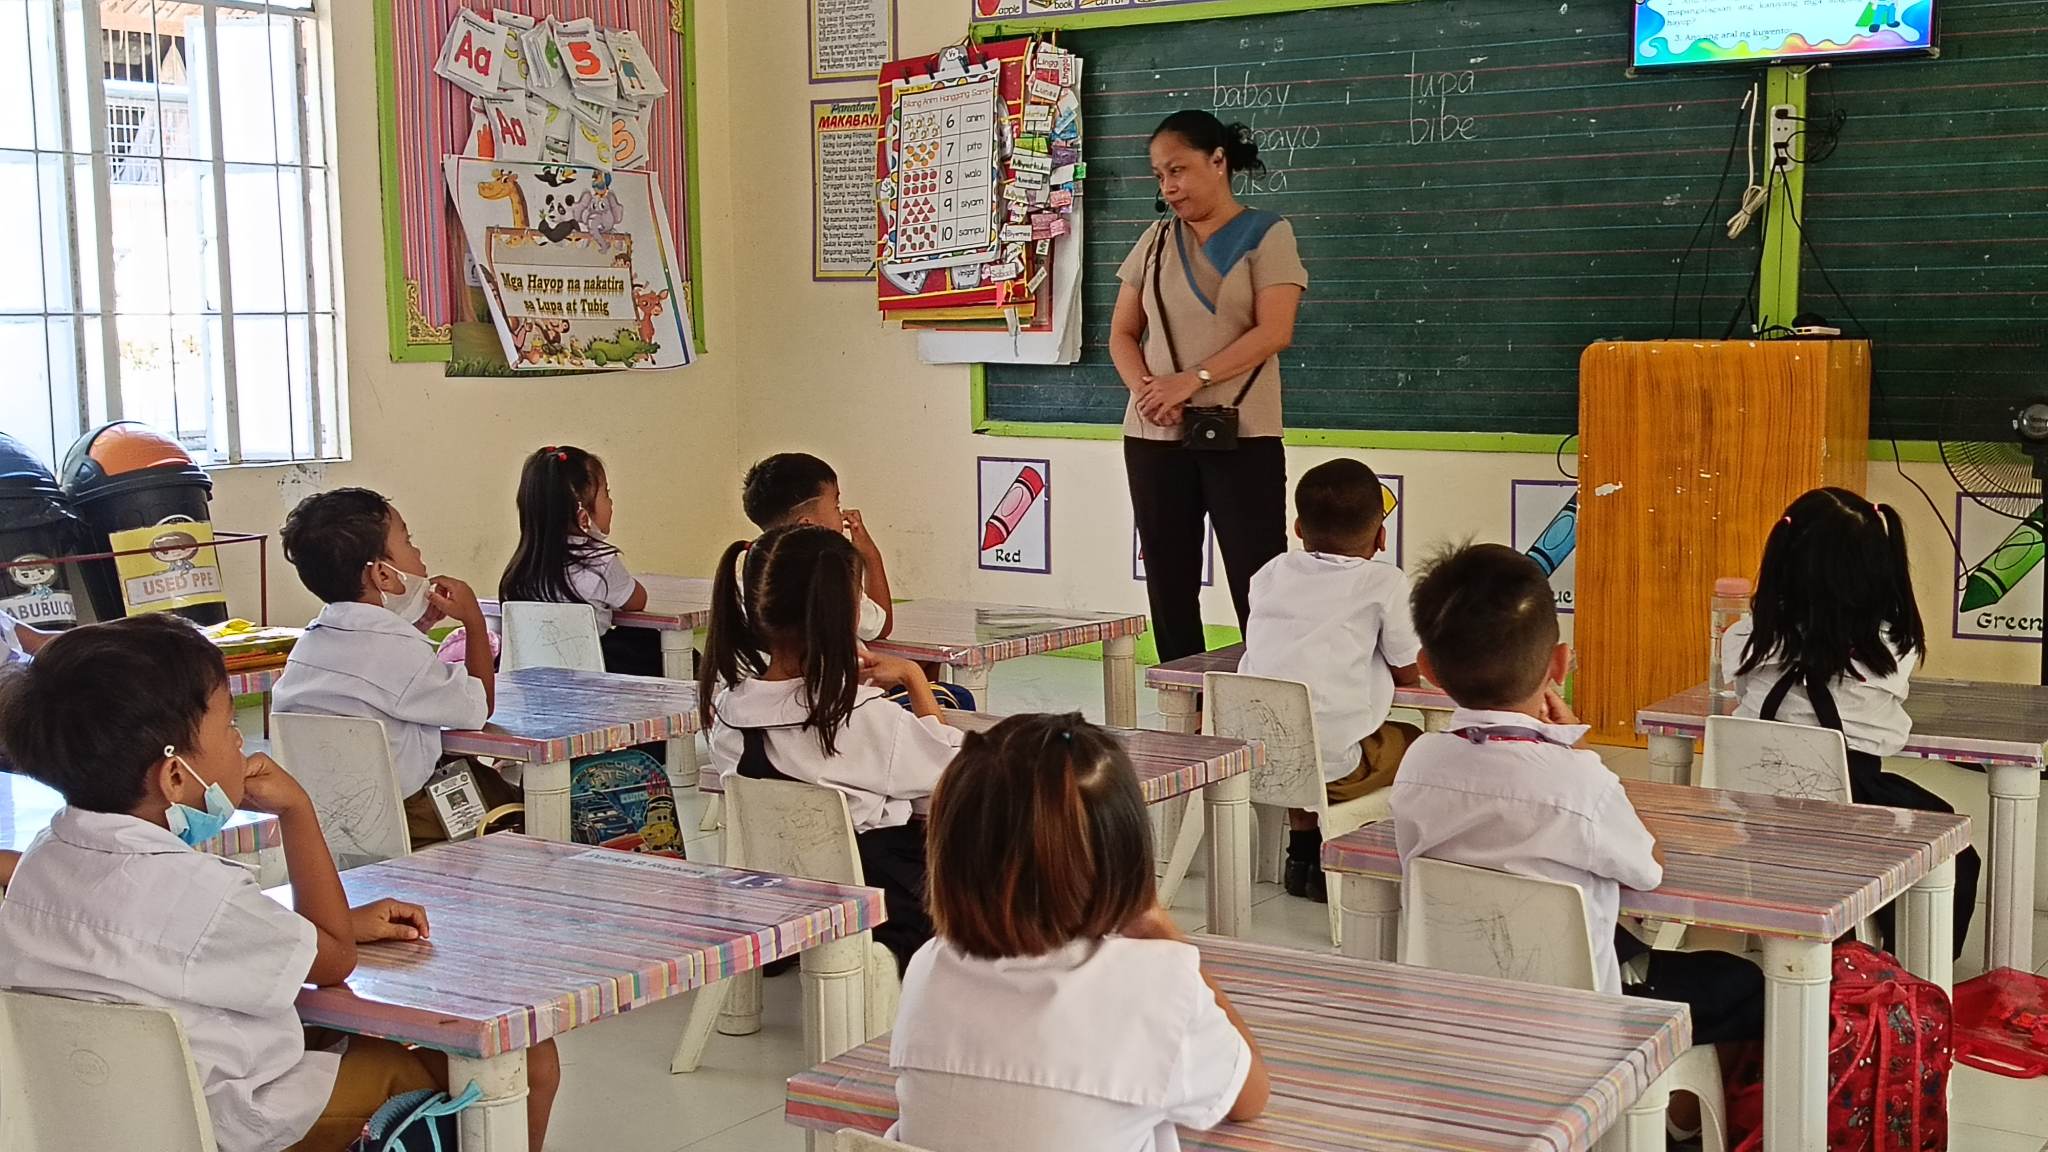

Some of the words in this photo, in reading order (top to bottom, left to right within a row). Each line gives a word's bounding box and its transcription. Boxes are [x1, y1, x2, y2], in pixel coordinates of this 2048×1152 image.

[998, 5, 1020, 15] apple
[1054, 0, 1073, 9] book
[454, 29, 492, 75] Aa
[567, 41, 601, 75] 5
[1404, 51, 1474, 99] tupa
[1213, 68, 1290, 118] baboy
[494, 108, 527, 147] Aa
[818, 114, 880, 128] MAKABAY
[946, 114, 955, 128] 6
[966, 114, 985, 123] anim
[612, 119, 636, 160] 5
[946, 142, 954, 157] 7
[945, 170, 953, 184] 8
[964, 169, 982, 179] walo
[1232, 170, 1288, 195] aka
[944, 198, 952, 212] 9
[960, 198, 984, 208] siyam
[941, 227, 953, 241] 10
[959, 227, 985, 237] sampu
[501, 272, 523, 291] Mga
[527, 273, 564, 293] Hayop
[567, 279, 580, 290] na
[583, 275, 624, 291] nakatira
[524, 300, 535, 310] sa
[536, 298, 563, 314] Lupa
[566, 299, 577, 312] at
[580, 298, 609, 316] Tubig
[995, 549, 1021, 563] Red
[143, 575, 188, 595] USED
[192, 571, 214, 587] PPE
[1555, 590, 1573, 603] ue
[6, 600, 75, 620] ABUBULO
[1977, 612, 2044, 631] Green
